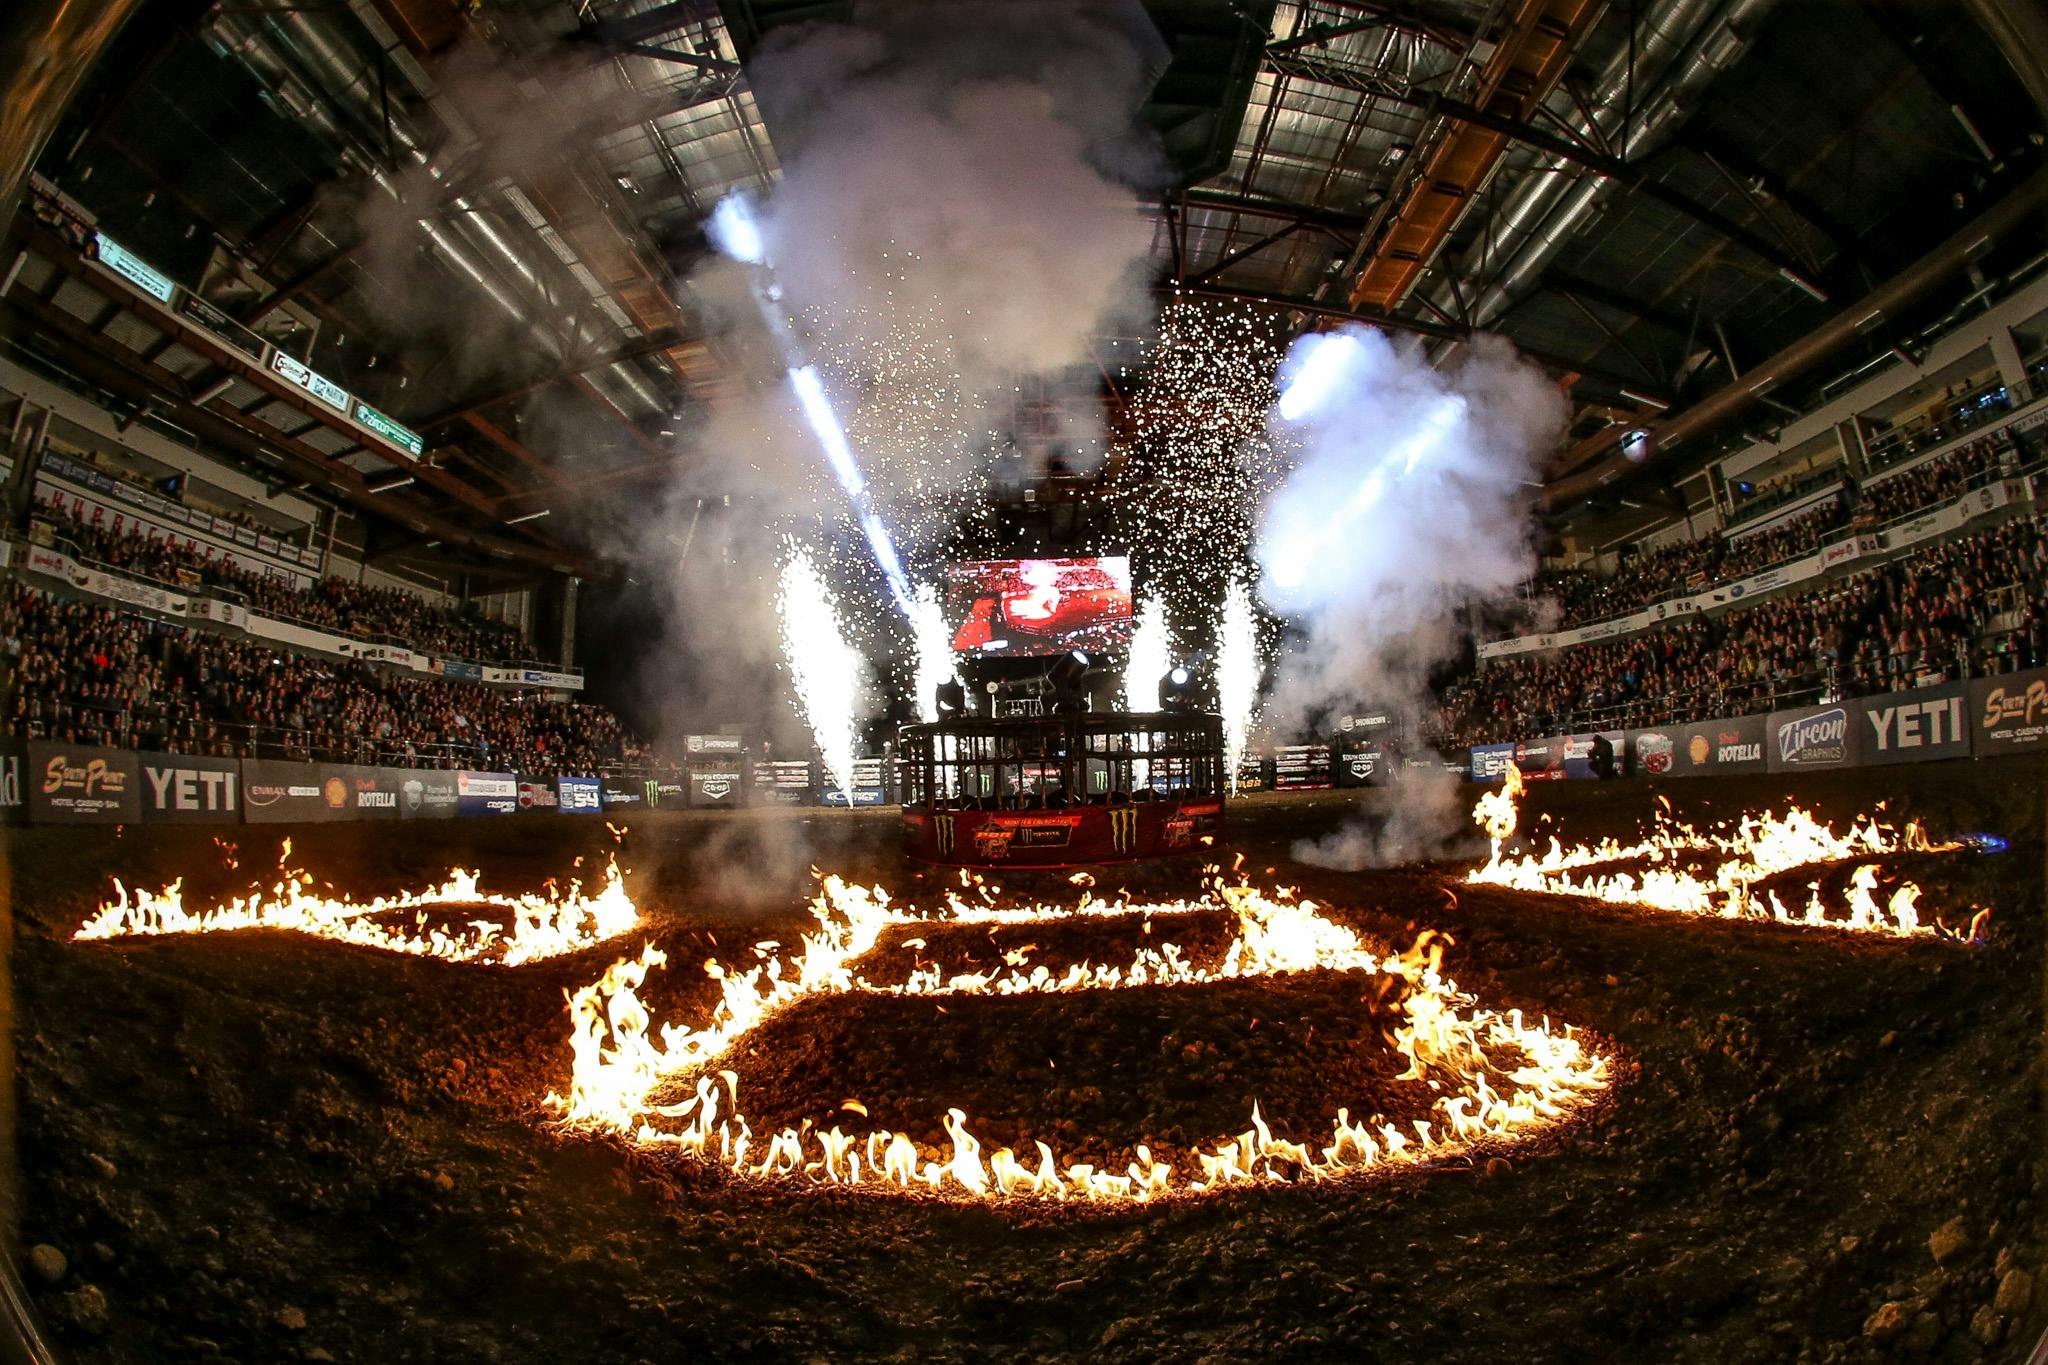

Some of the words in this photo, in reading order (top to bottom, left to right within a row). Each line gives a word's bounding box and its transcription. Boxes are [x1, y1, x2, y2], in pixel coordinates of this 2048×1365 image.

[1867, 697, 1965, 750] YETI
[1718, 744, 1760, 762] ROTELLA
[1779, 719, 1844, 762] Zircon
[1802, 746, 1842, 760] GRAPHICS
[144, 767, 236, 811] YETI
[357, 792, 396, 807] ROTELLA
